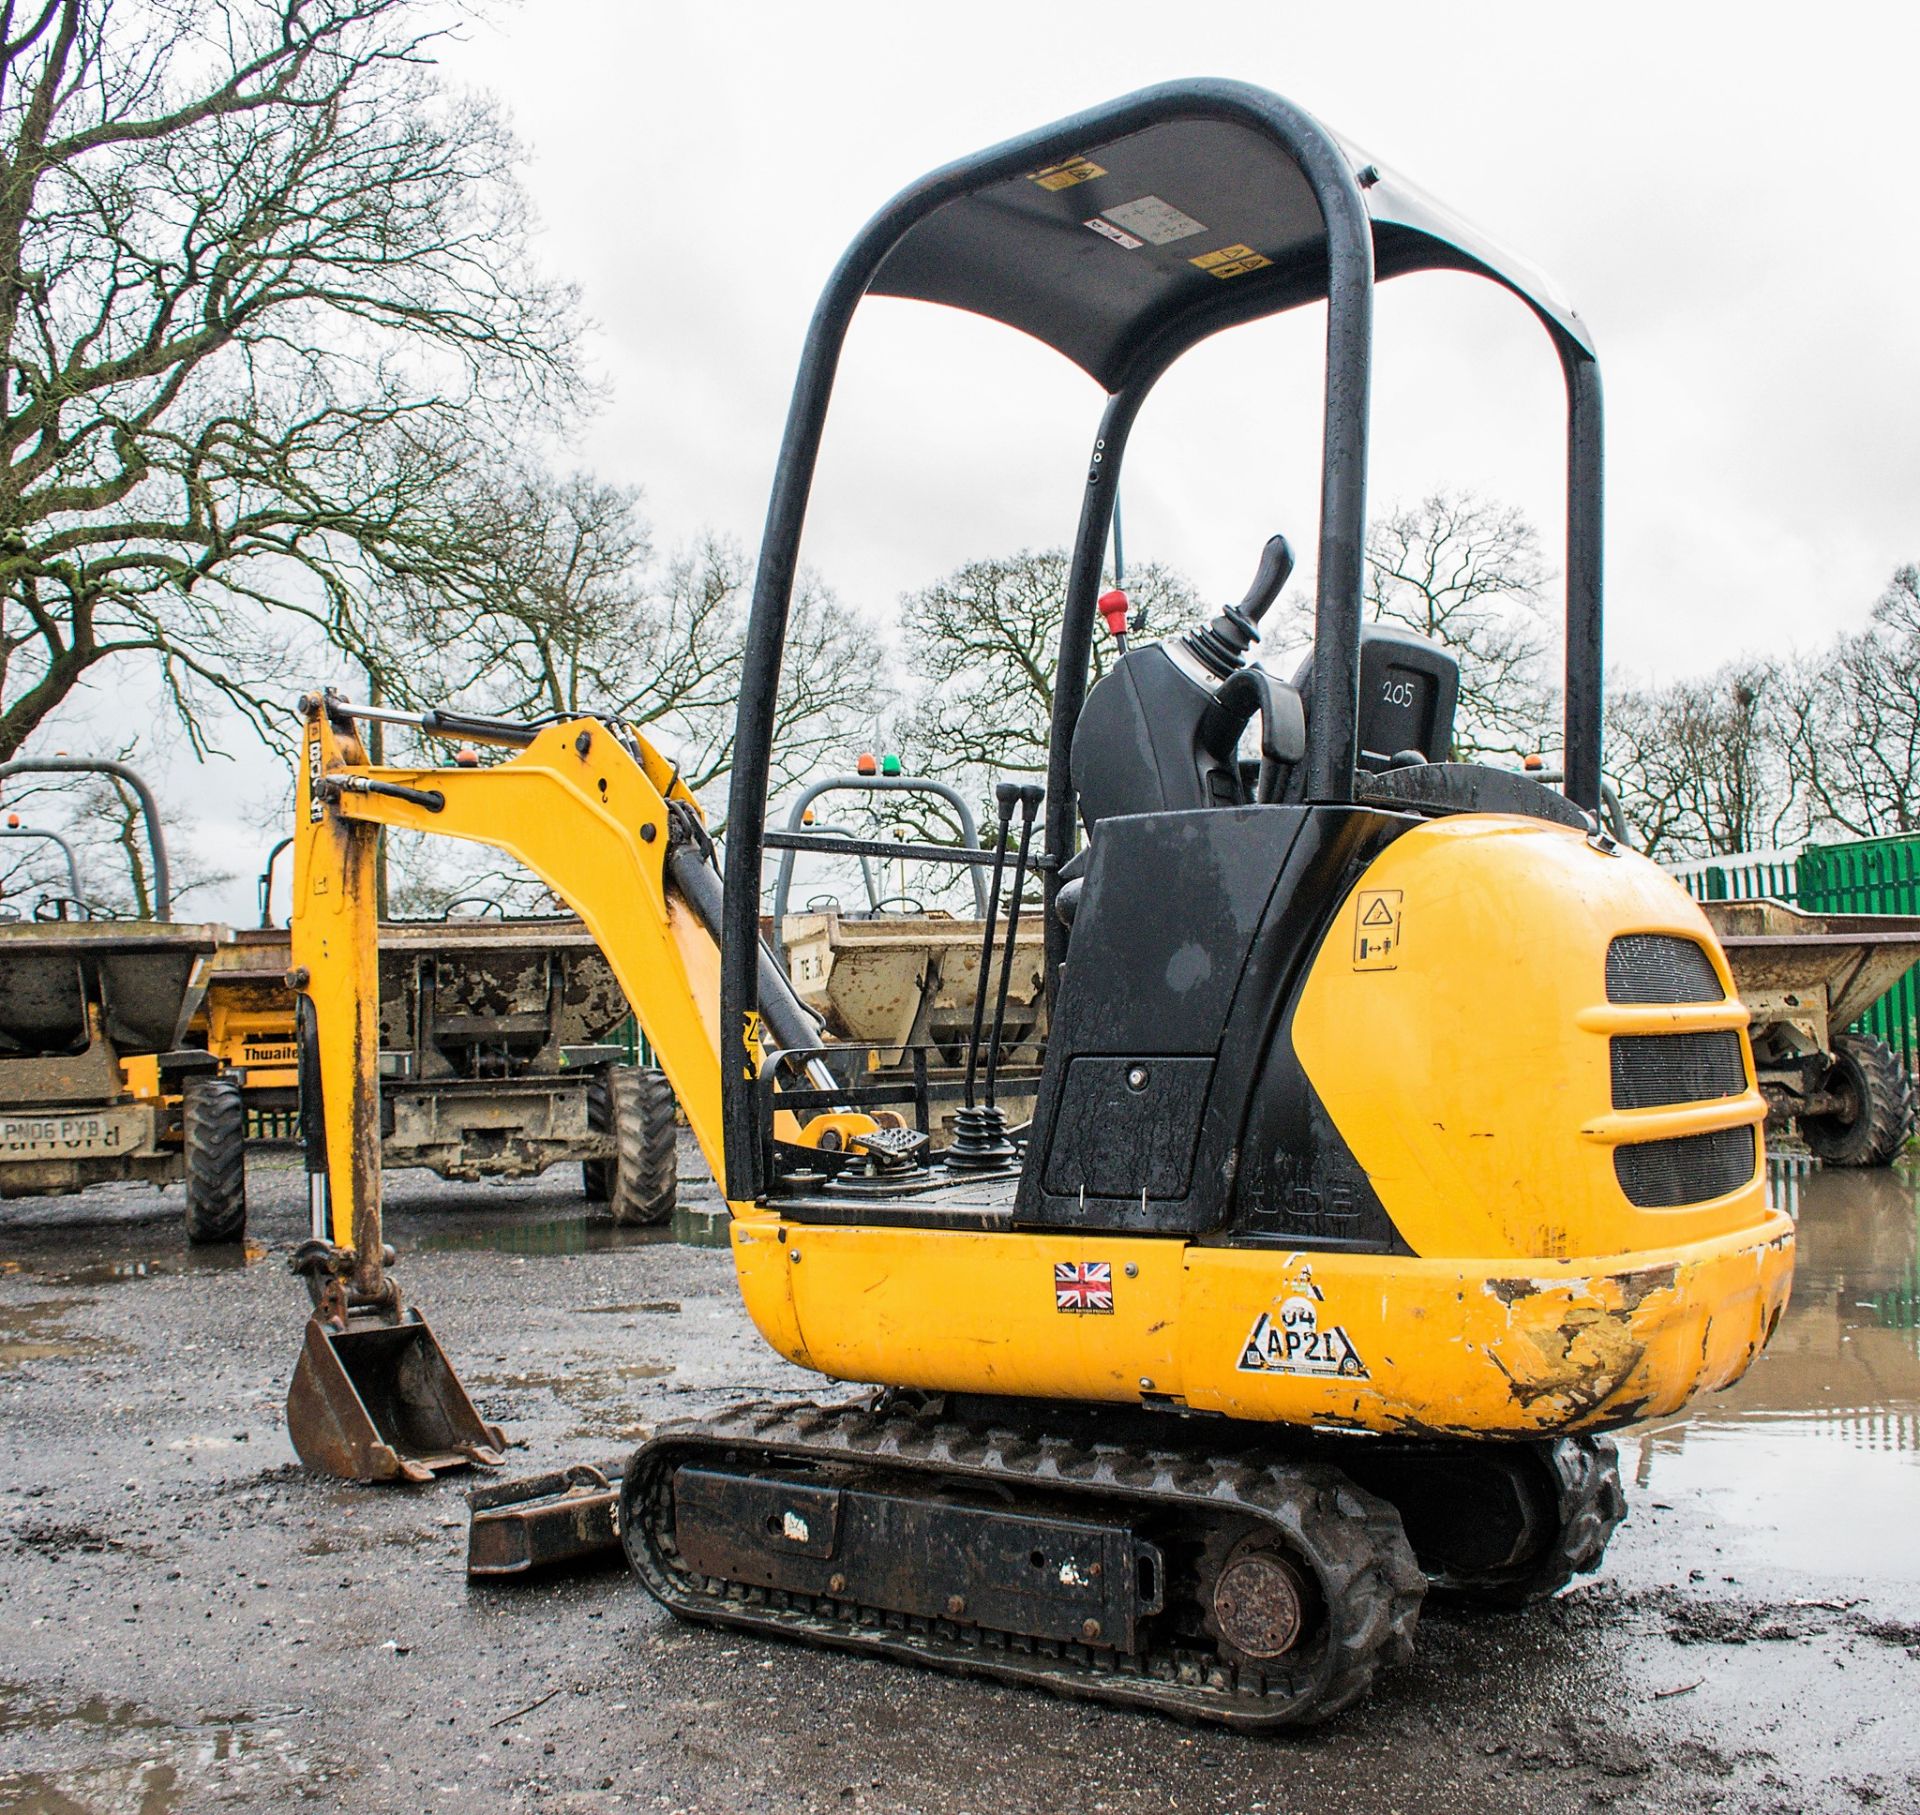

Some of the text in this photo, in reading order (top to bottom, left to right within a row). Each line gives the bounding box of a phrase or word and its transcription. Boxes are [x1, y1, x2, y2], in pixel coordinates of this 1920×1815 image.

[1382, 680, 1416, 708] 205
[244, 1046, 299, 1061] Thwaite
[61, 1120, 99, 1139] PYB
